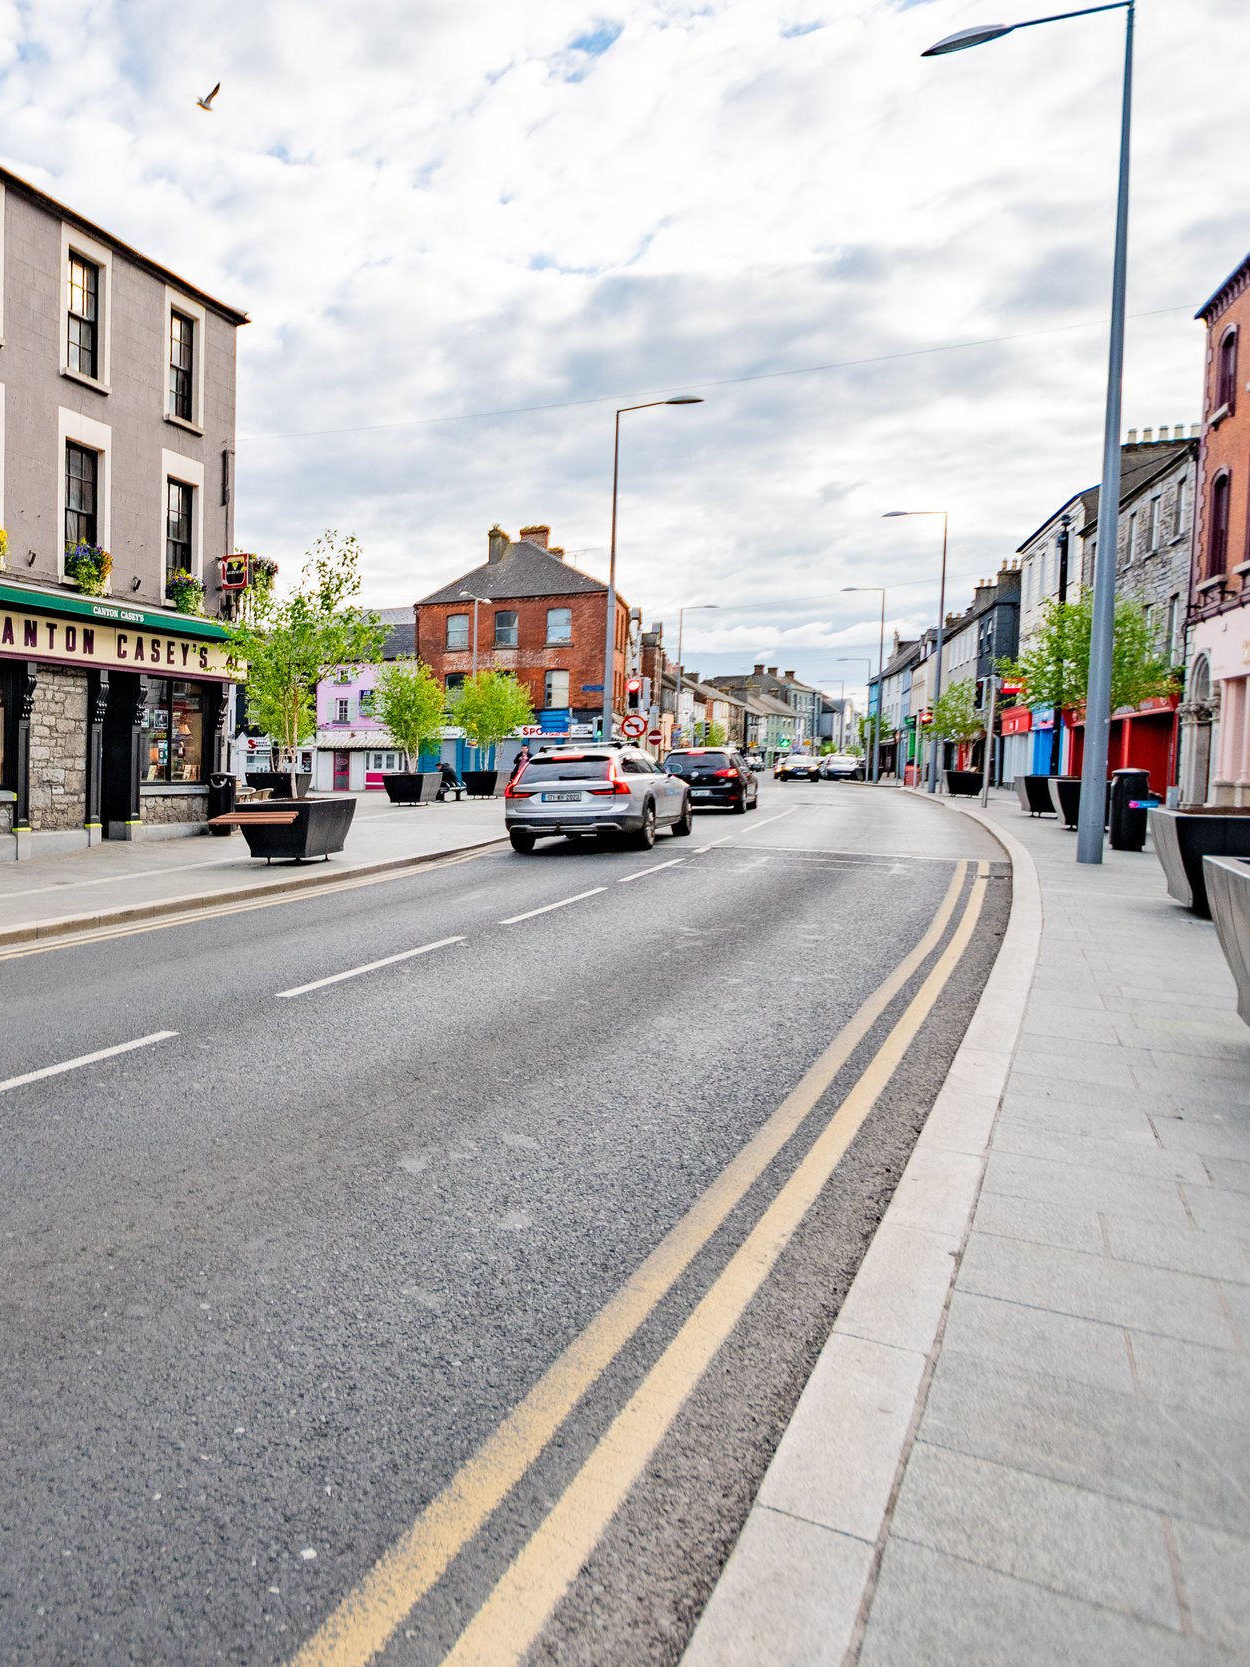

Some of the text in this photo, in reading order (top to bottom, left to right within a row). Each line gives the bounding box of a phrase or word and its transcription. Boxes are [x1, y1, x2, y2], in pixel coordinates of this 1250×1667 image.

[93, 605, 144, 623] CANTON CASEY'S
[117, 634, 208, 669] CASEY'S
